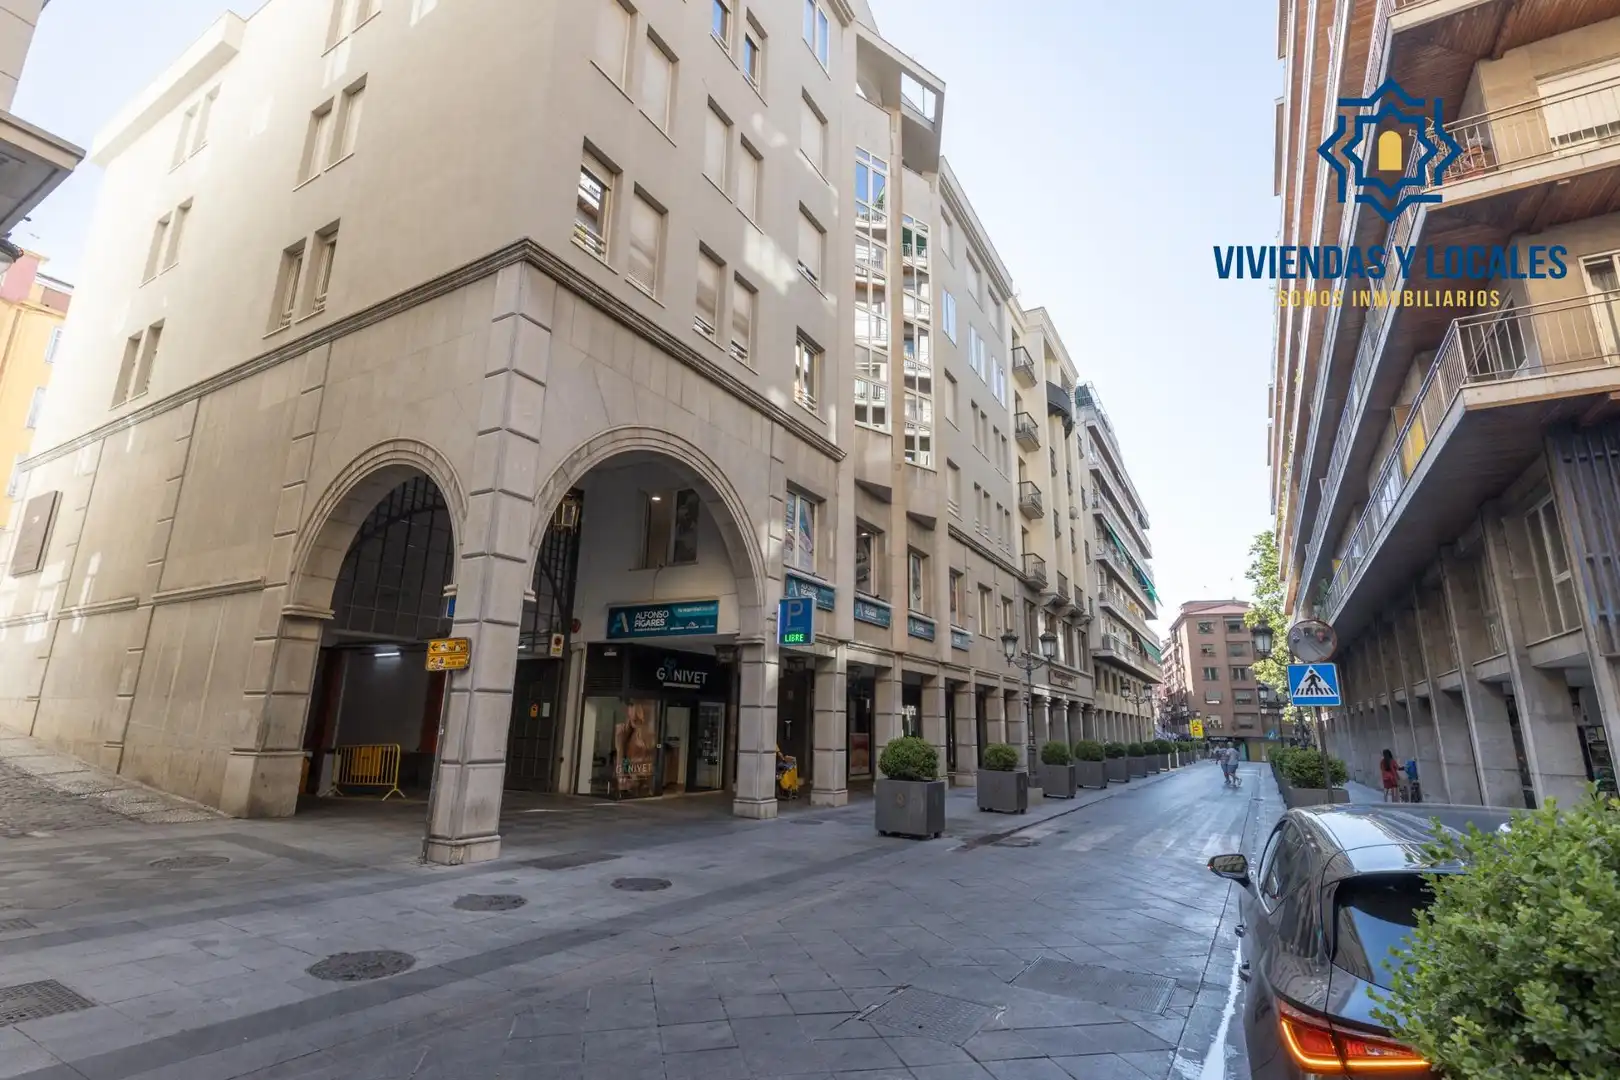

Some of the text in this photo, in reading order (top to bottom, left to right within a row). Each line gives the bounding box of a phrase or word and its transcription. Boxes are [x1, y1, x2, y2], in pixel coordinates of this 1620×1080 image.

[635, 610, 669, 620] ALFONSO
[786, 600, 804, 626] P
[634, 618, 665, 628] FIGARES
[784, 633, 805, 643] LIBRE
